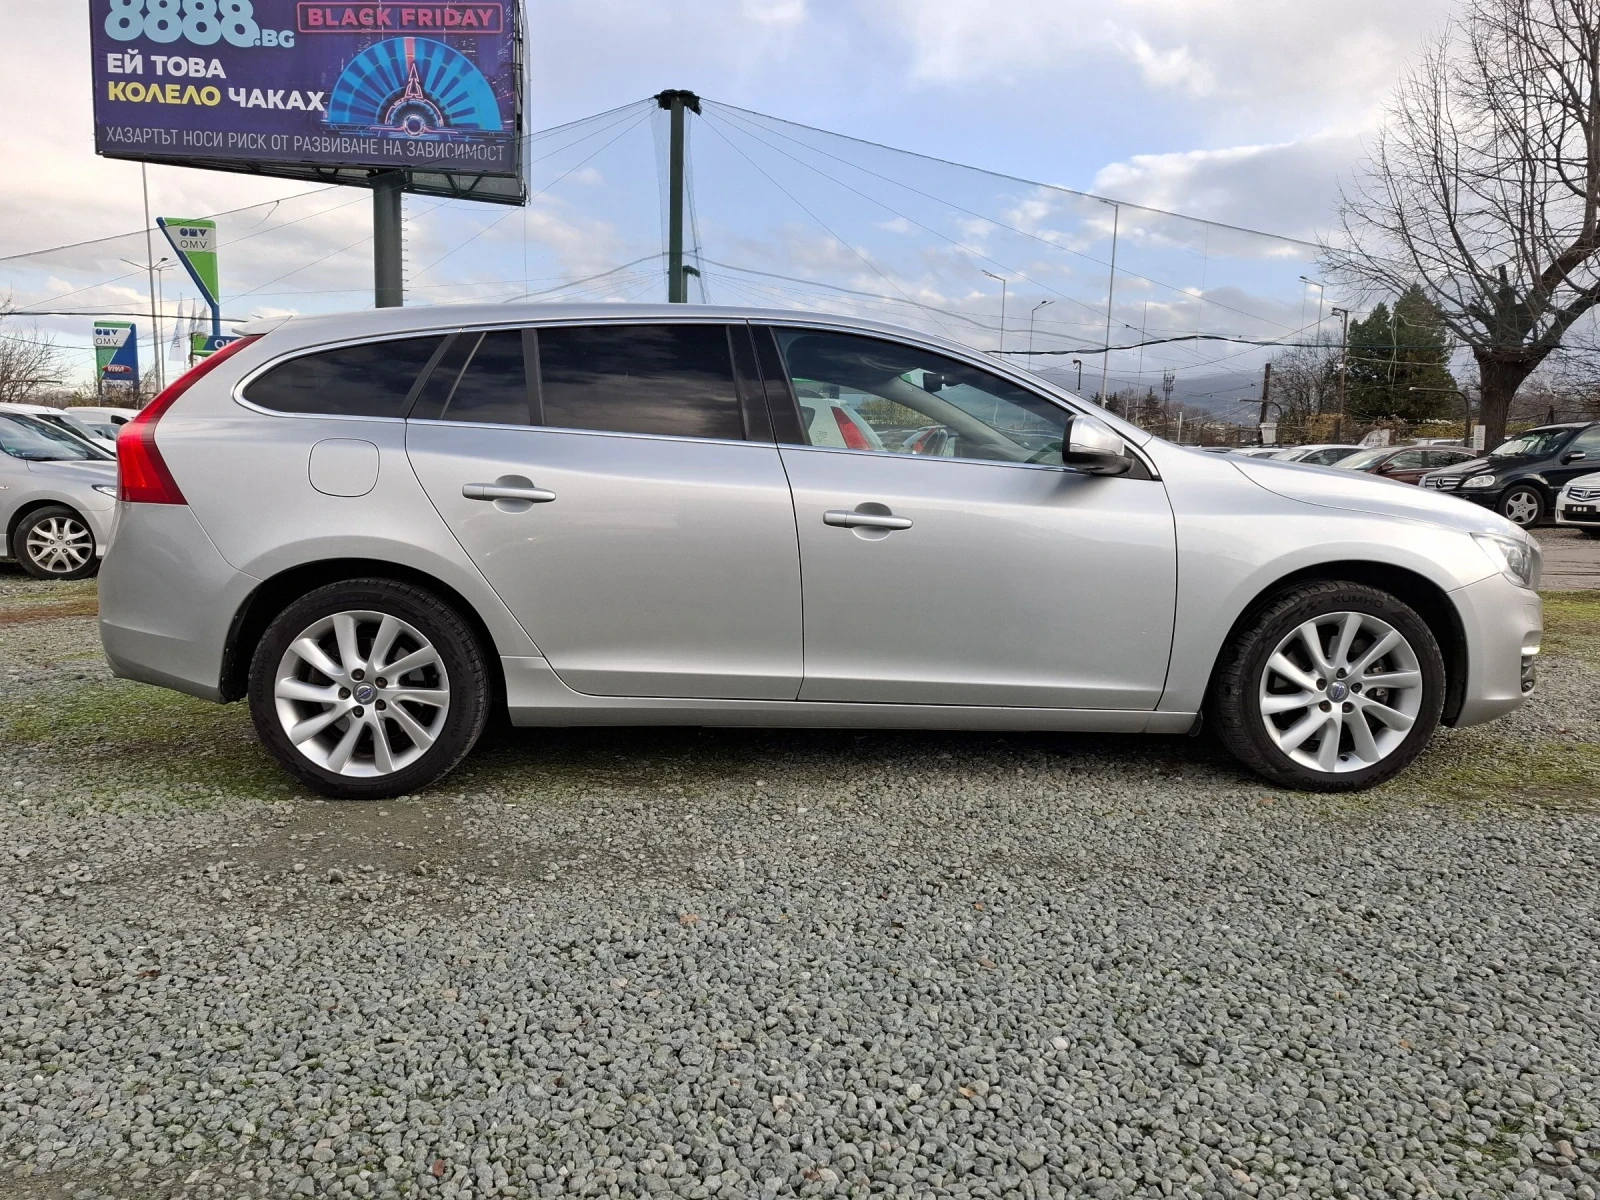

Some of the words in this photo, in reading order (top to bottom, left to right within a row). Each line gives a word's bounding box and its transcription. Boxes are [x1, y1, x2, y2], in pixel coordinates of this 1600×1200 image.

[308, 8, 392, 26] BLACK
[401, 8, 493, 27] FRIDAY
[107, 48, 143, 75] ЕЙ
[151, 55, 227, 79] ТОВА
[108, 81, 221, 106] КОЛЕЛО
[228, 87, 325, 111] ЧАКАХ
[106, 126, 178, 145] ХАЗАРТЪТ
[183, 130, 223, 148] НОСИ
[228, 132, 267, 150] РИСК
[271, 134, 289, 151] ОТ
[294, 135, 378, 155] РАЗВИВАНЕ
[383, 139, 402, 156] НА
[406, 140, 505, 161] ЗАВИСИМОСТ
[180, 240, 207, 249] OMV
[1331, 595, 1384, 609] KUMHO
